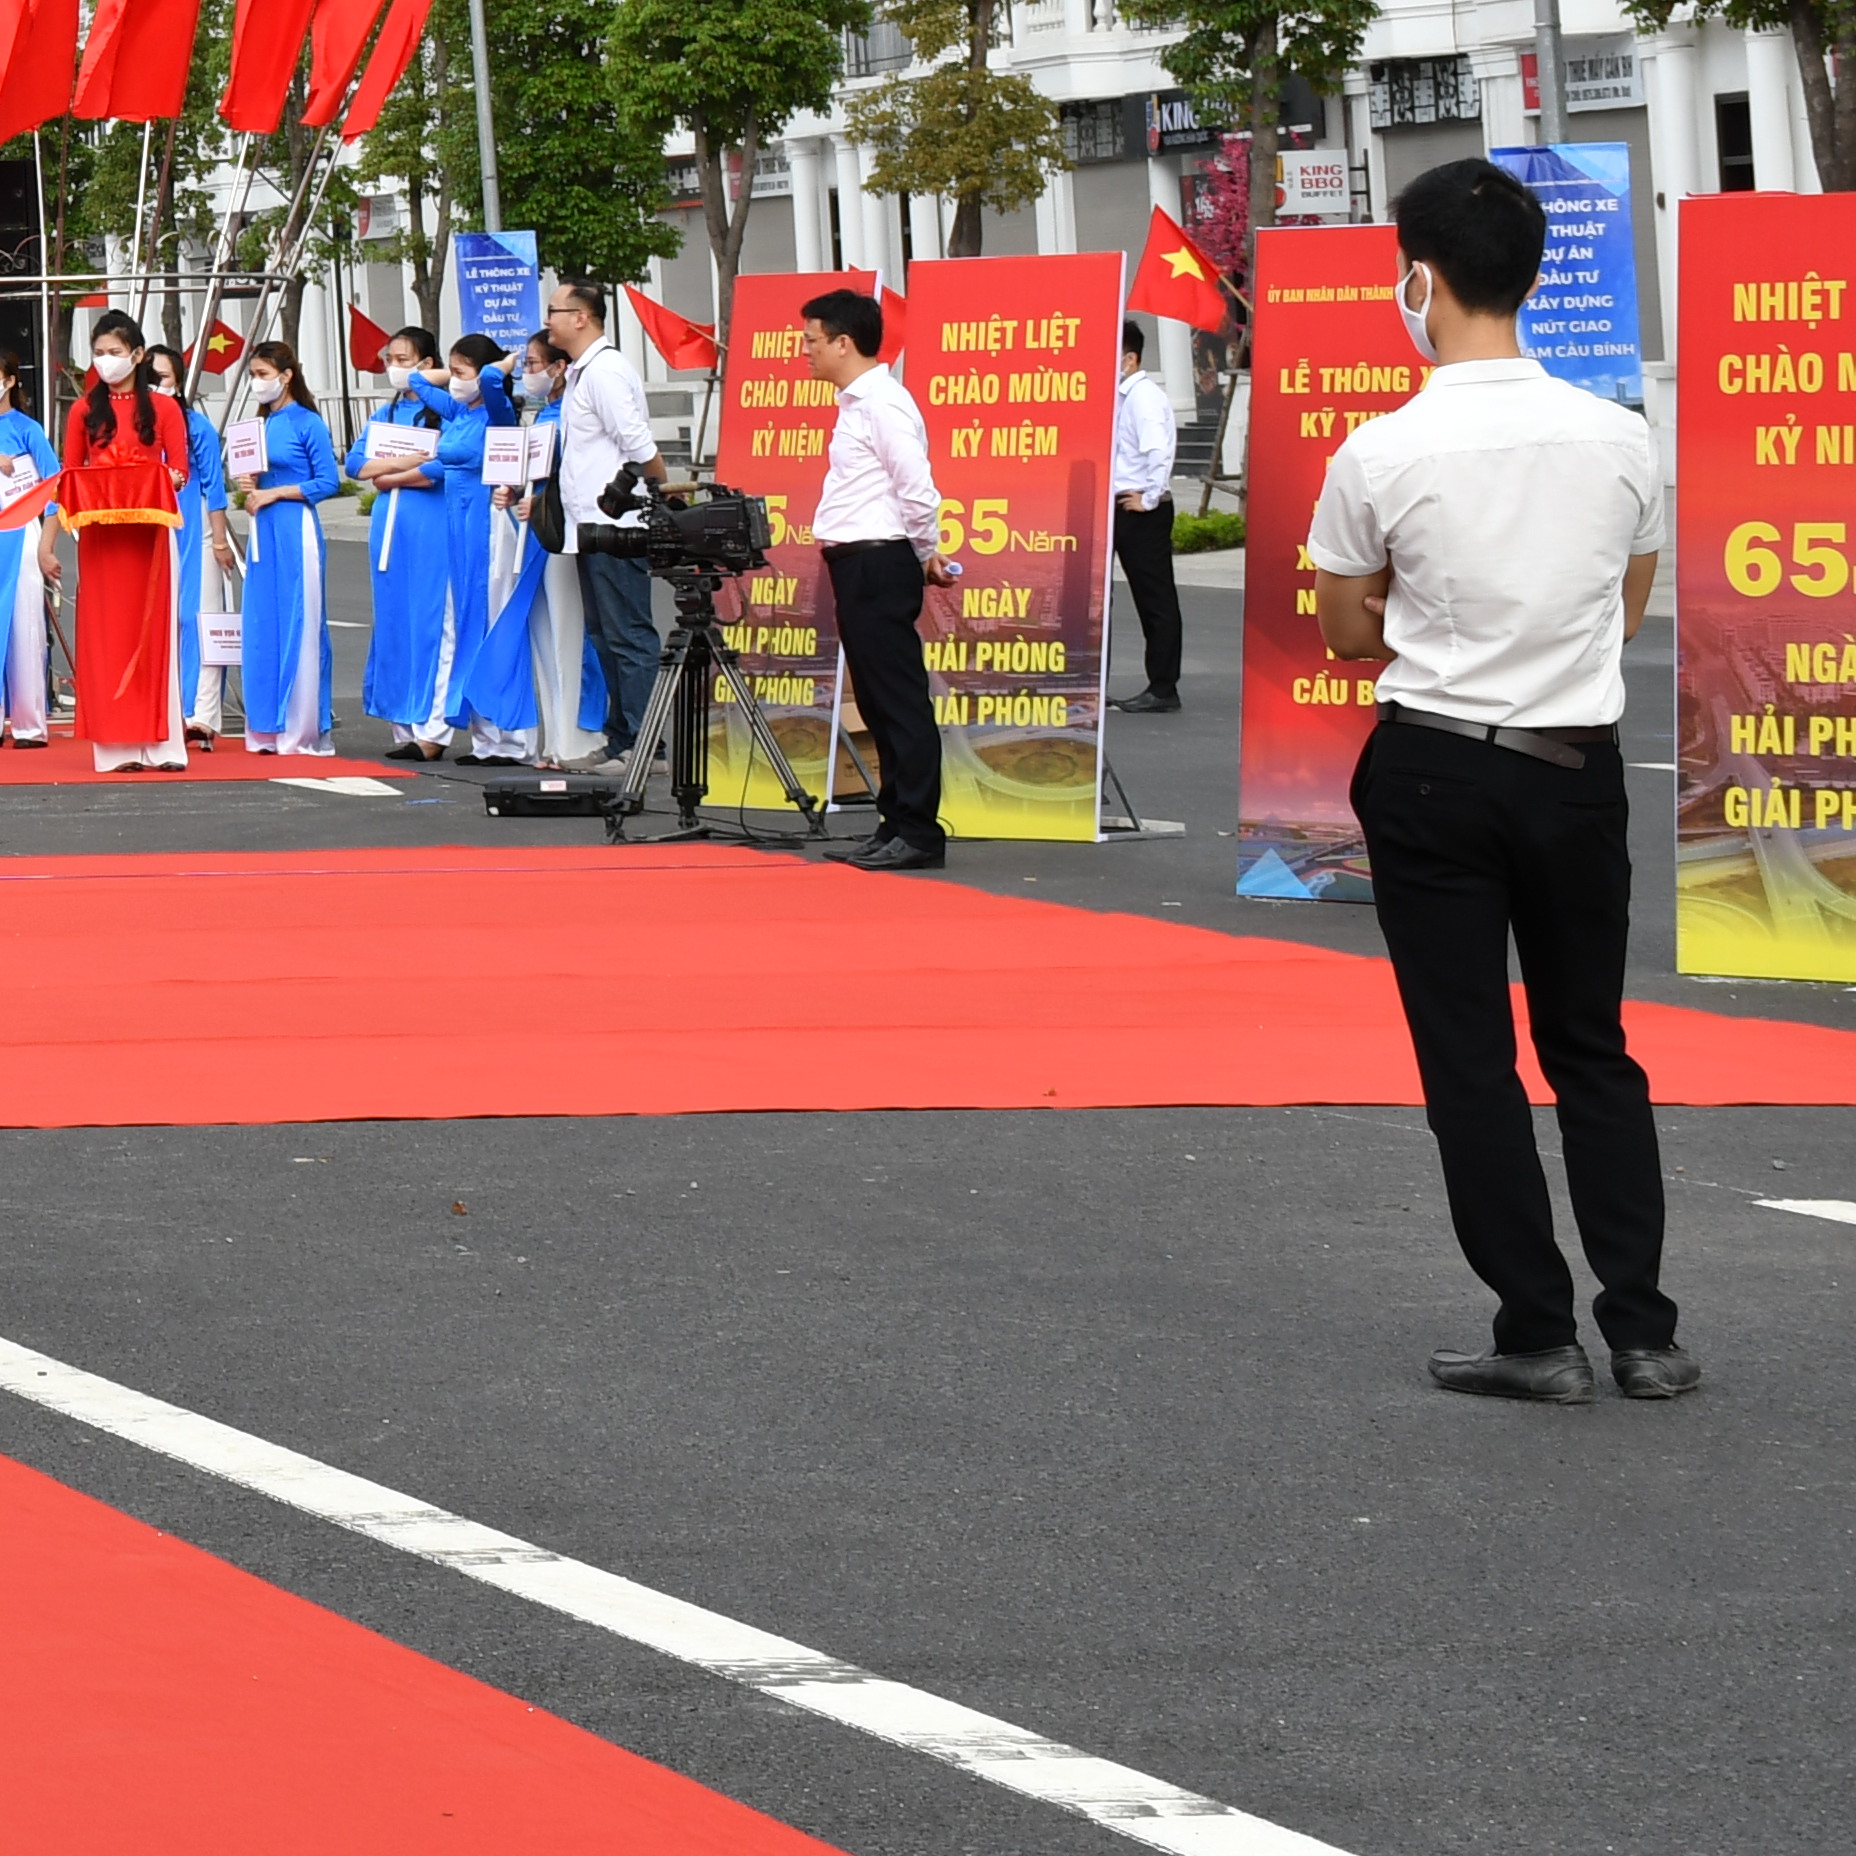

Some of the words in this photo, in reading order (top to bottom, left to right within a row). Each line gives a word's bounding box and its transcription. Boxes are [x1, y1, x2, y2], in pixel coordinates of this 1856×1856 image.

[1300, 164, 1343, 176] KING
[1300, 176, 1344, 189] BBQ
[1542, 198, 1592, 214] HÔNG
[1595, 198, 1619, 211] XE
[1549, 221, 1606, 240] THUẬT
[479, 265, 516, 278] THÔNG
[516, 267, 531, 277] XE
[491, 282, 524, 295] THUẬT
[1576, 269, 1600, 284] TƯ
[1267, 284, 1281, 303] ỦY
[1283, 288, 1304, 303] BAN
[1306, 285, 1335, 302] NHÂN
[1337, 285, 1358, 302] DÂN
[1360, 285, 1394, 301] THÀNH
[1527, 295, 1560, 311] XÂY
[1563, 294, 1614, 312] DỰNG
[1733, 271, 1847, 330] NHIỆT
[499, 327, 528, 339] DỰNG
[752, 325, 804, 364] NHIỆT
[941, 314, 1018, 357] NHIỆT
[1025, 311, 1081, 355] LIỆT
[1531, 319, 1566, 335] NÚT
[1569, 319, 1612, 334] GIAO
[1523, 346, 1552, 359] AM
[1555, 340, 1590, 358] CẦU
[928, 368, 1000, 406] CHÀO
[1008, 365, 1087, 403] MỪNG
[1280, 358, 1311, 394] LỄ
[1319, 361, 1410, 393] THÔNG
[1718, 344, 1824, 395] CHÀO
[740, 375, 789, 409] CHÀO
[1300, 406, 1336, 438] KỸ
[1756, 413, 1803, 466] KỶ
[1816, 425, 1855, 465] NI
[752, 420, 776, 457] KỶ
[778, 422, 824, 464] NIỆM
[950, 419, 984, 459] KỶ
[991, 419, 1059, 463] NIỆM
[765, 495, 788, 547] 5
[936, 498, 1009, 555] 65
[1010, 530, 1078, 553] Năm
[1724, 520, 1849, 598] 65
[750, 571, 799, 605] NGÀY
[962, 581, 1032, 618] NGÀY
[756, 625, 817, 657] PHÒNG
[924, 634, 967, 673] HẢI
[975, 633, 1066, 673] PHÒNG
[1786, 633, 1856, 684] NGÀ
[754, 670, 815, 706] PHÓNG
[1292, 669, 1348, 706] CẦU
[935, 687, 968, 726] IẢI
[975, 687, 1068, 727] PHÓNG
[1730, 703, 1795, 756] HẢI
[1724, 776, 1801, 829] GIẢI
